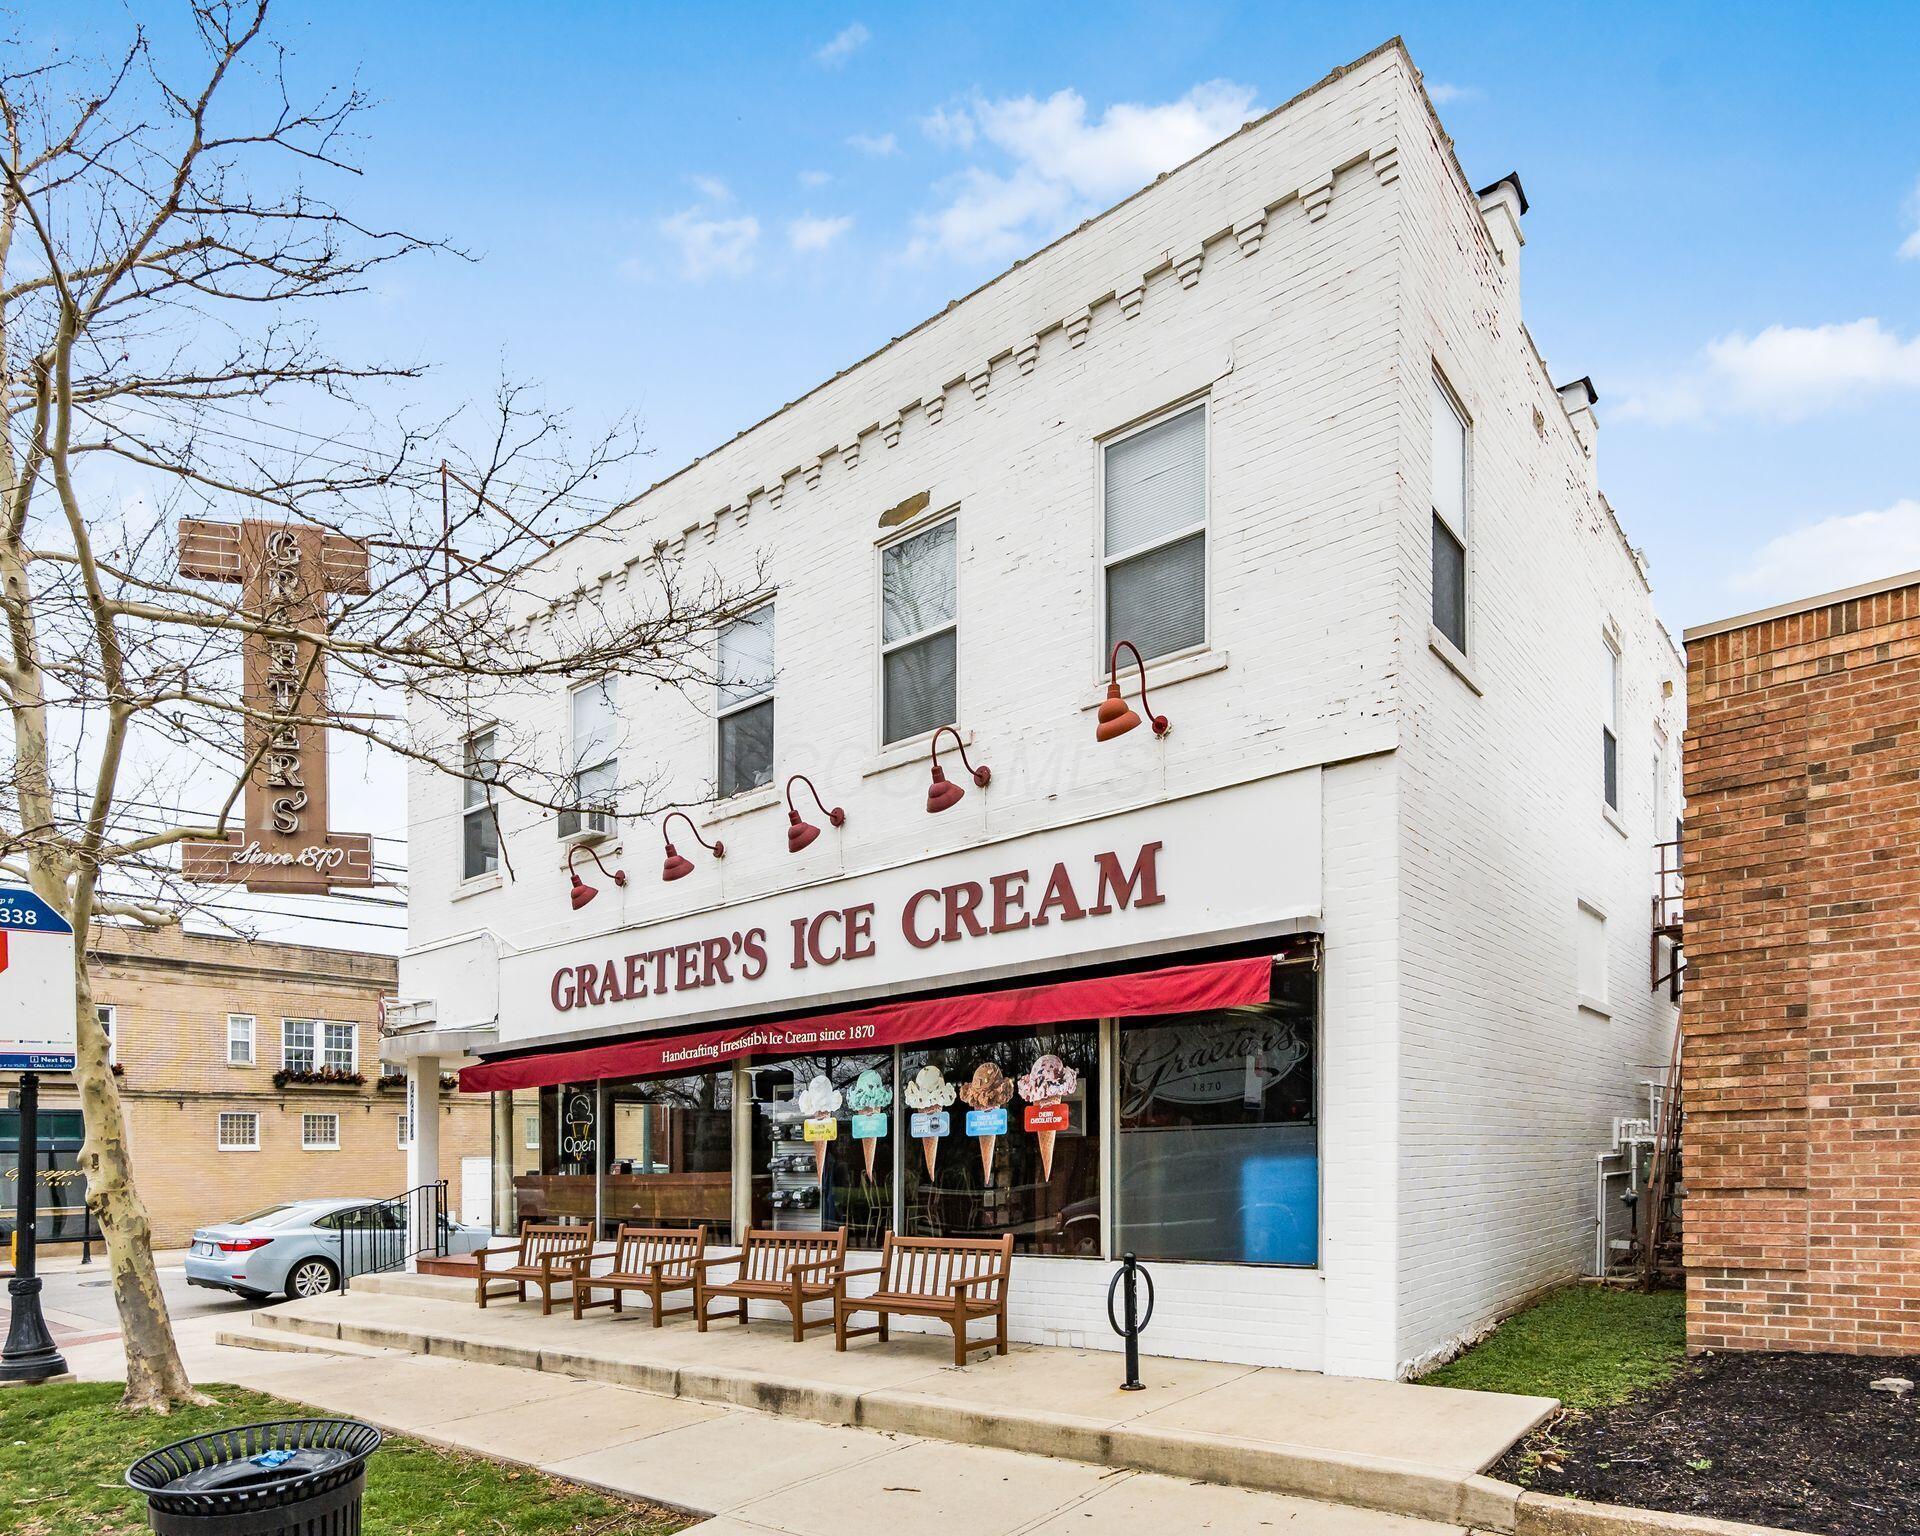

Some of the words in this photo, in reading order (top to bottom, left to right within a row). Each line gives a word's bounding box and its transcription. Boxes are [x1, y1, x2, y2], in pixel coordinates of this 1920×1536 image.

[231, 840, 294, 866] Since
[295, 845, 344, 873] 1870
[550, 927, 768, 1012] GRAETER'S
[790, 902, 876, 970] ICE
[901, 840, 1166, 949] CREAM
[662, 1043, 719, 1064] Handcrafting
[769, 1030, 783, 1045] Ice
[785, 1030, 818, 1045] Cream
[819, 1026, 846, 1042] since
[849, 1024, 875, 1040] 1870
[1191, 1081, 1222, 1093] 1870
[563, 1136, 595, 1157] Open
